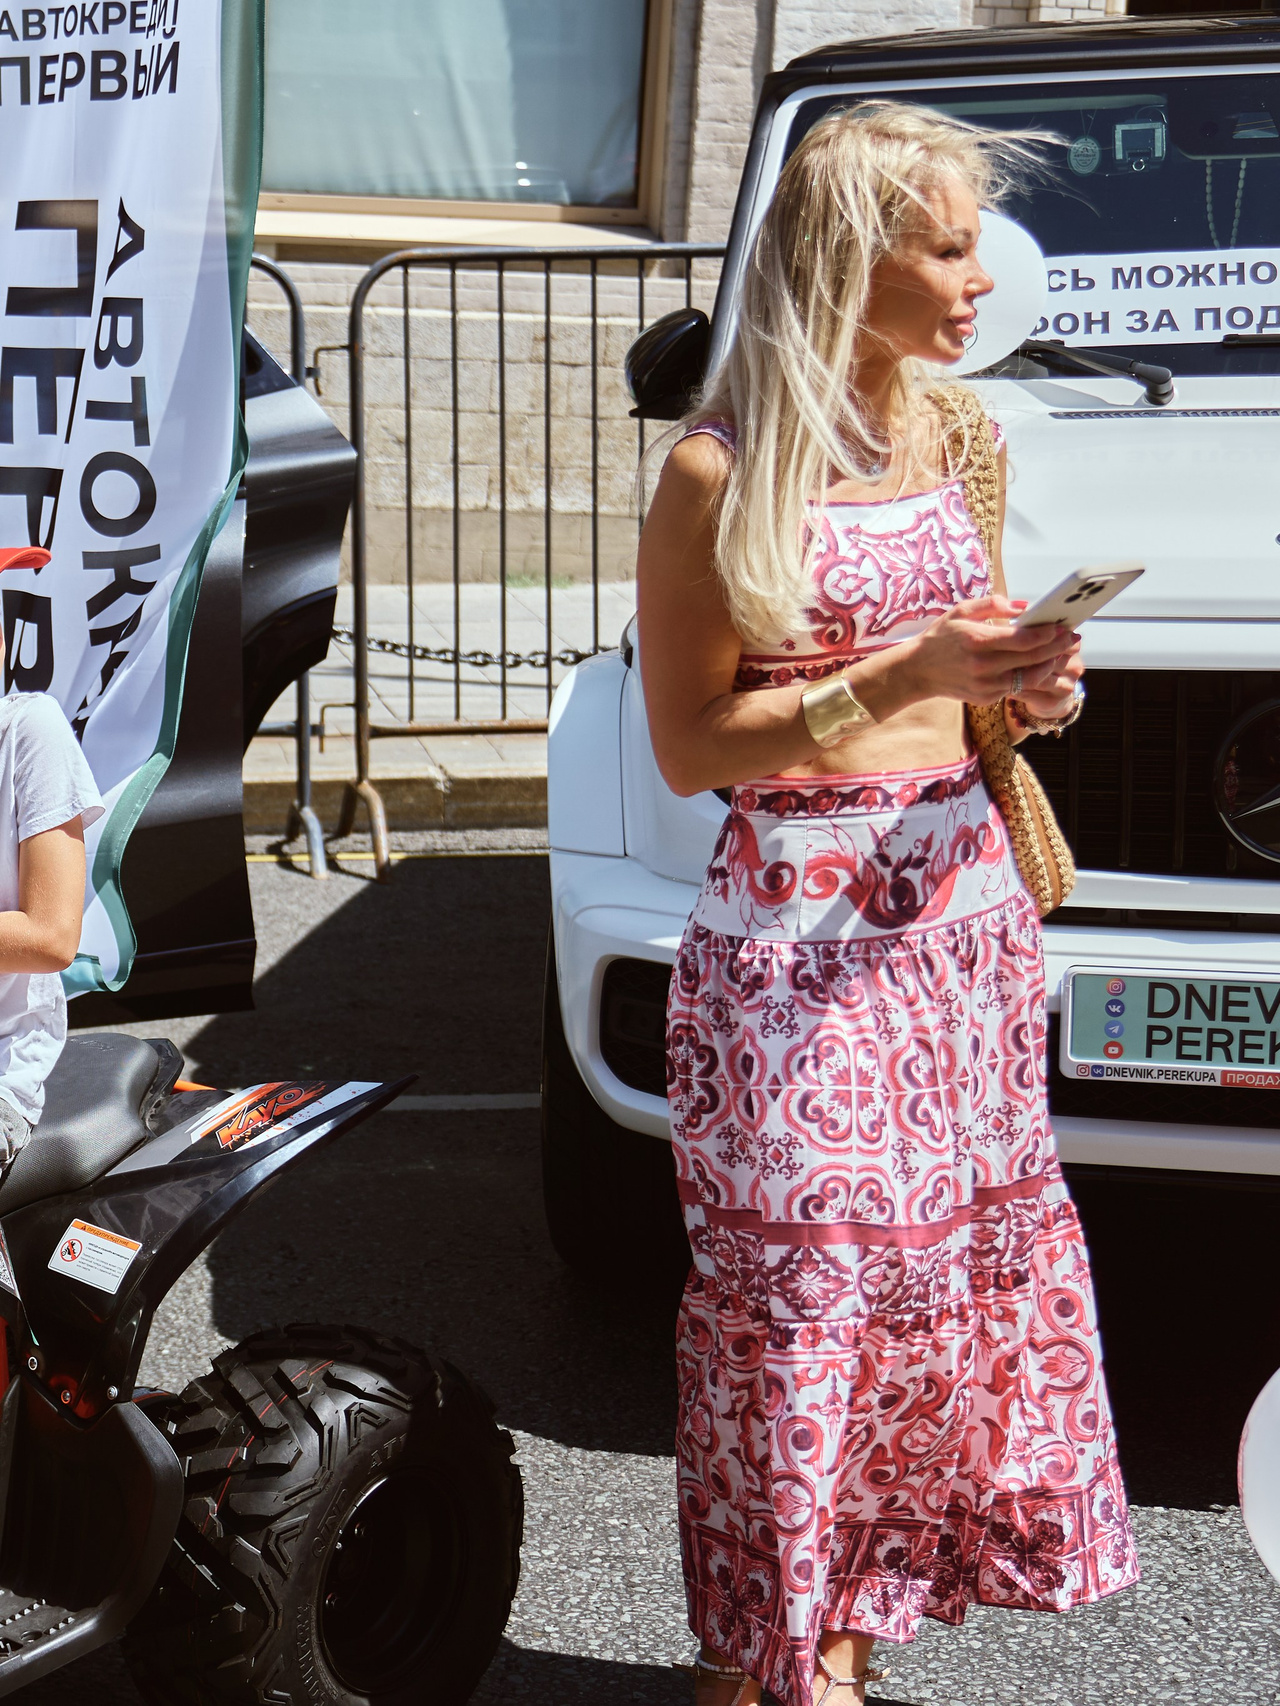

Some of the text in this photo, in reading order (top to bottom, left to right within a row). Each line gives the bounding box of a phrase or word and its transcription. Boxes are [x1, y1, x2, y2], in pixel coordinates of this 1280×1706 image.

[1047, 261, 1278, 292] СЬ МОЖНО
[1125, 308, 1180, 335] ЗА
[1194, 305, 1280, 334] ПОД
[1147, 981, 1280, 1024] DNEV
[1105, 1066, 1217, 1083] DNEVNIK.PEREKUPA
[216, 1087, 304, 1149] KAYO
